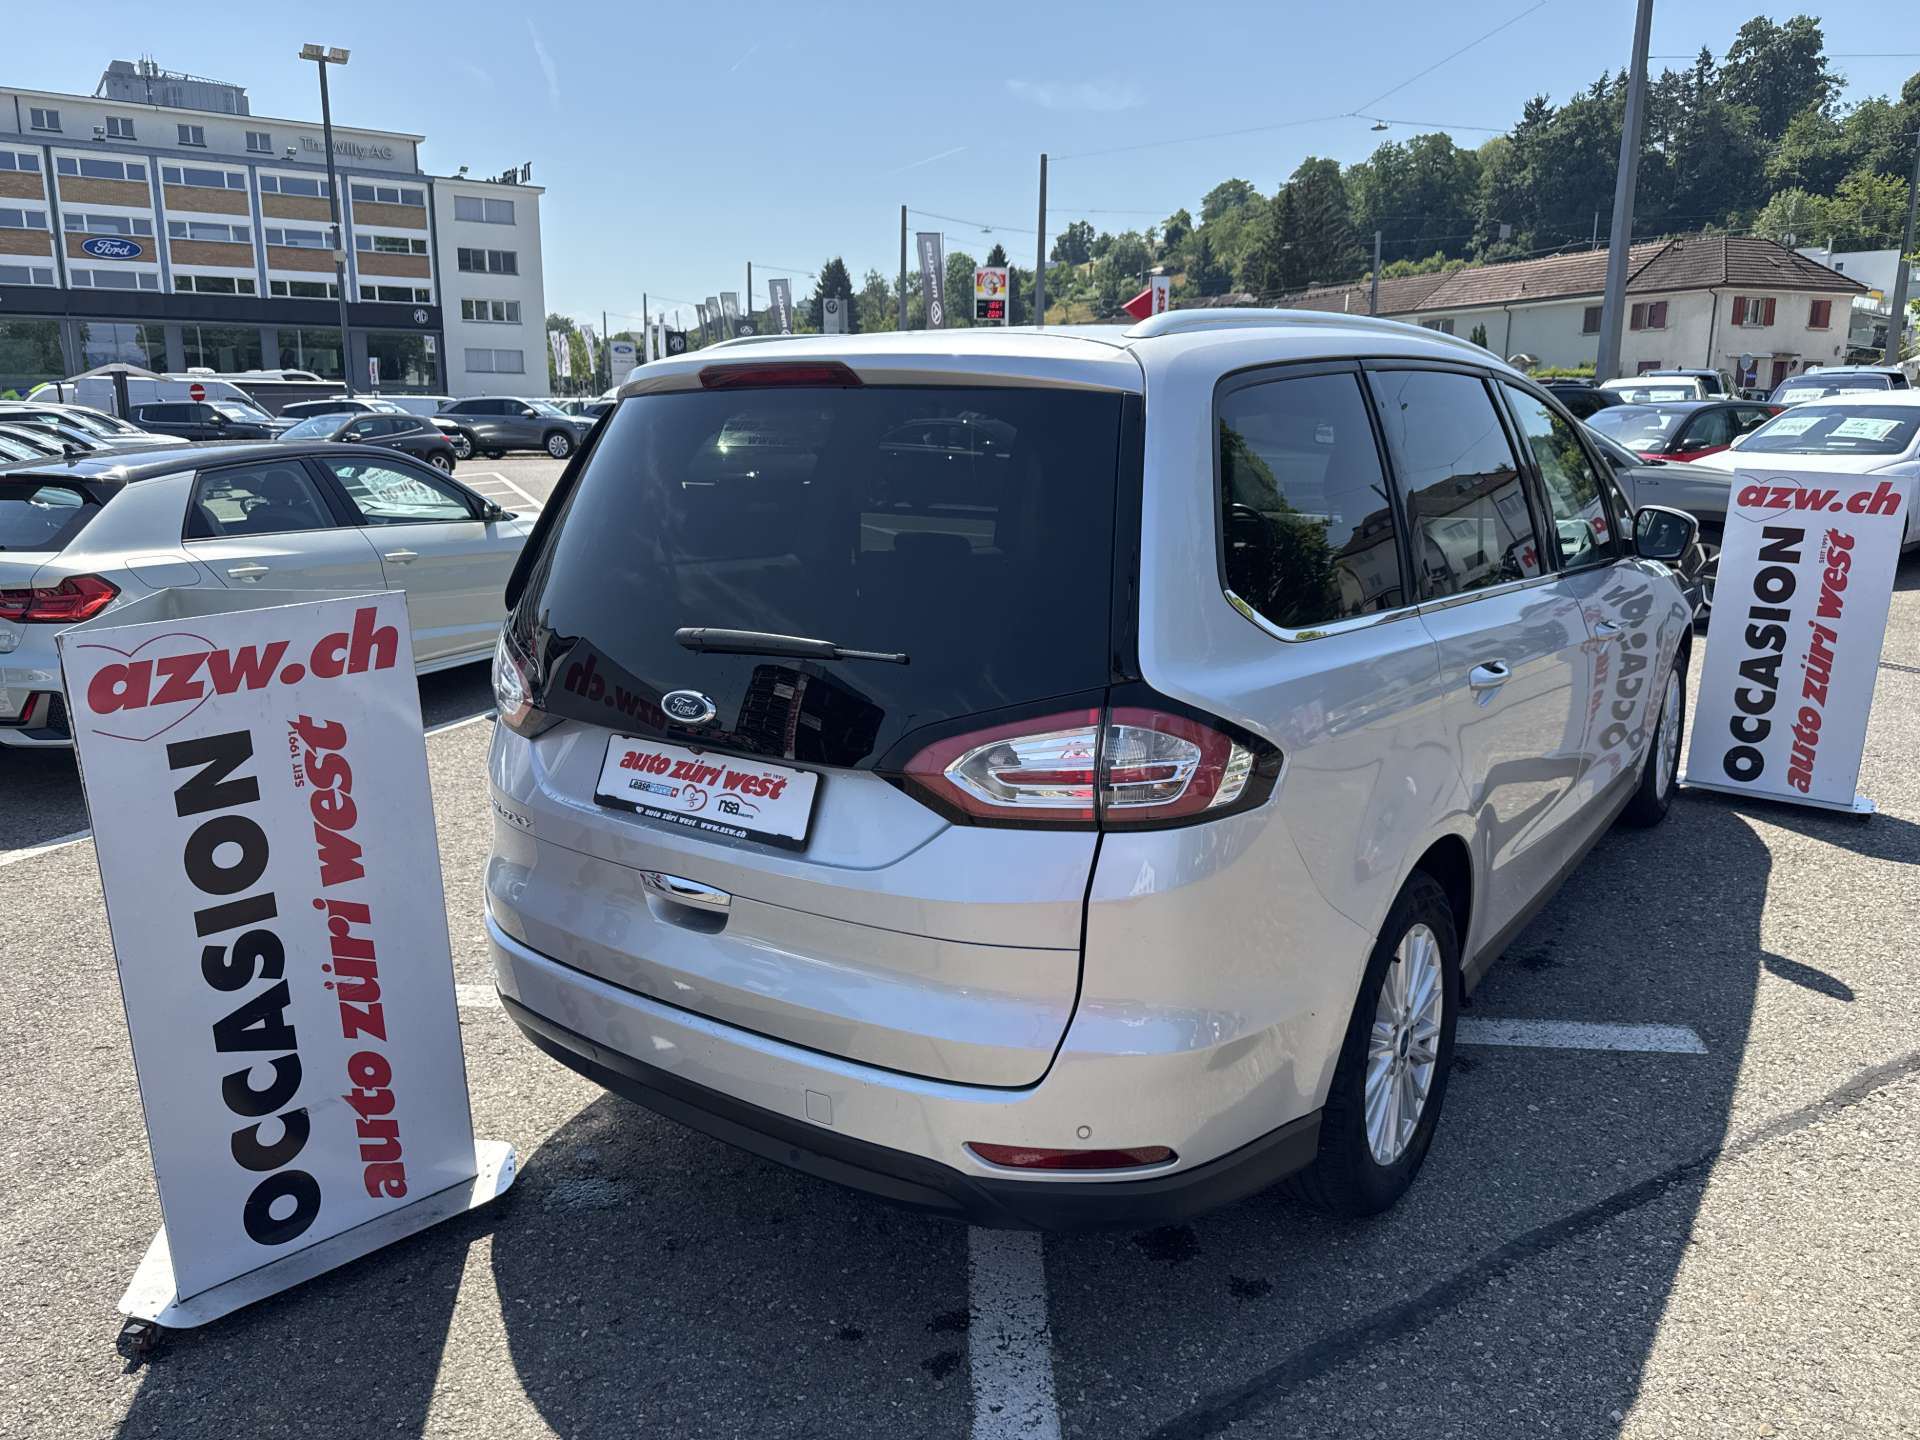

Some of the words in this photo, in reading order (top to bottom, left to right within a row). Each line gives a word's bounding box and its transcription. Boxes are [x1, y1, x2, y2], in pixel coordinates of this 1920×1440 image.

[368, 143, 393, 160] AG
[1737, 481, 1902, 516] azw.ch
[1816, 528, 1855, 619] west
[88, 608, 398, 714] azw.ch
[1723, 526, 1805, 782] OCCASION
[1801, 621, 1837, 707] züri
[288, 730, 301, 759] 1991
[293, 763, 305, 788] SEIT
[619, 751, 671, 775] auto
[668, 759, 726, 786] züri
[723, 770, 788, 800] west
[1787, 706, 1822, 794] auto
[287, 714, 366, 886] west
[645, 809, 660, 818] auto
[662, 812, 679, 822] züri
[679, 817, 697, 827] west
[700, 822, 748, 839] www.azw.ch
[718, 800, 740, 815] nsa
[166, 729, 322, 1246] OCCASION
[312, 898, 387, 1042] züri
[341, 1053, 409, 1199] auto
